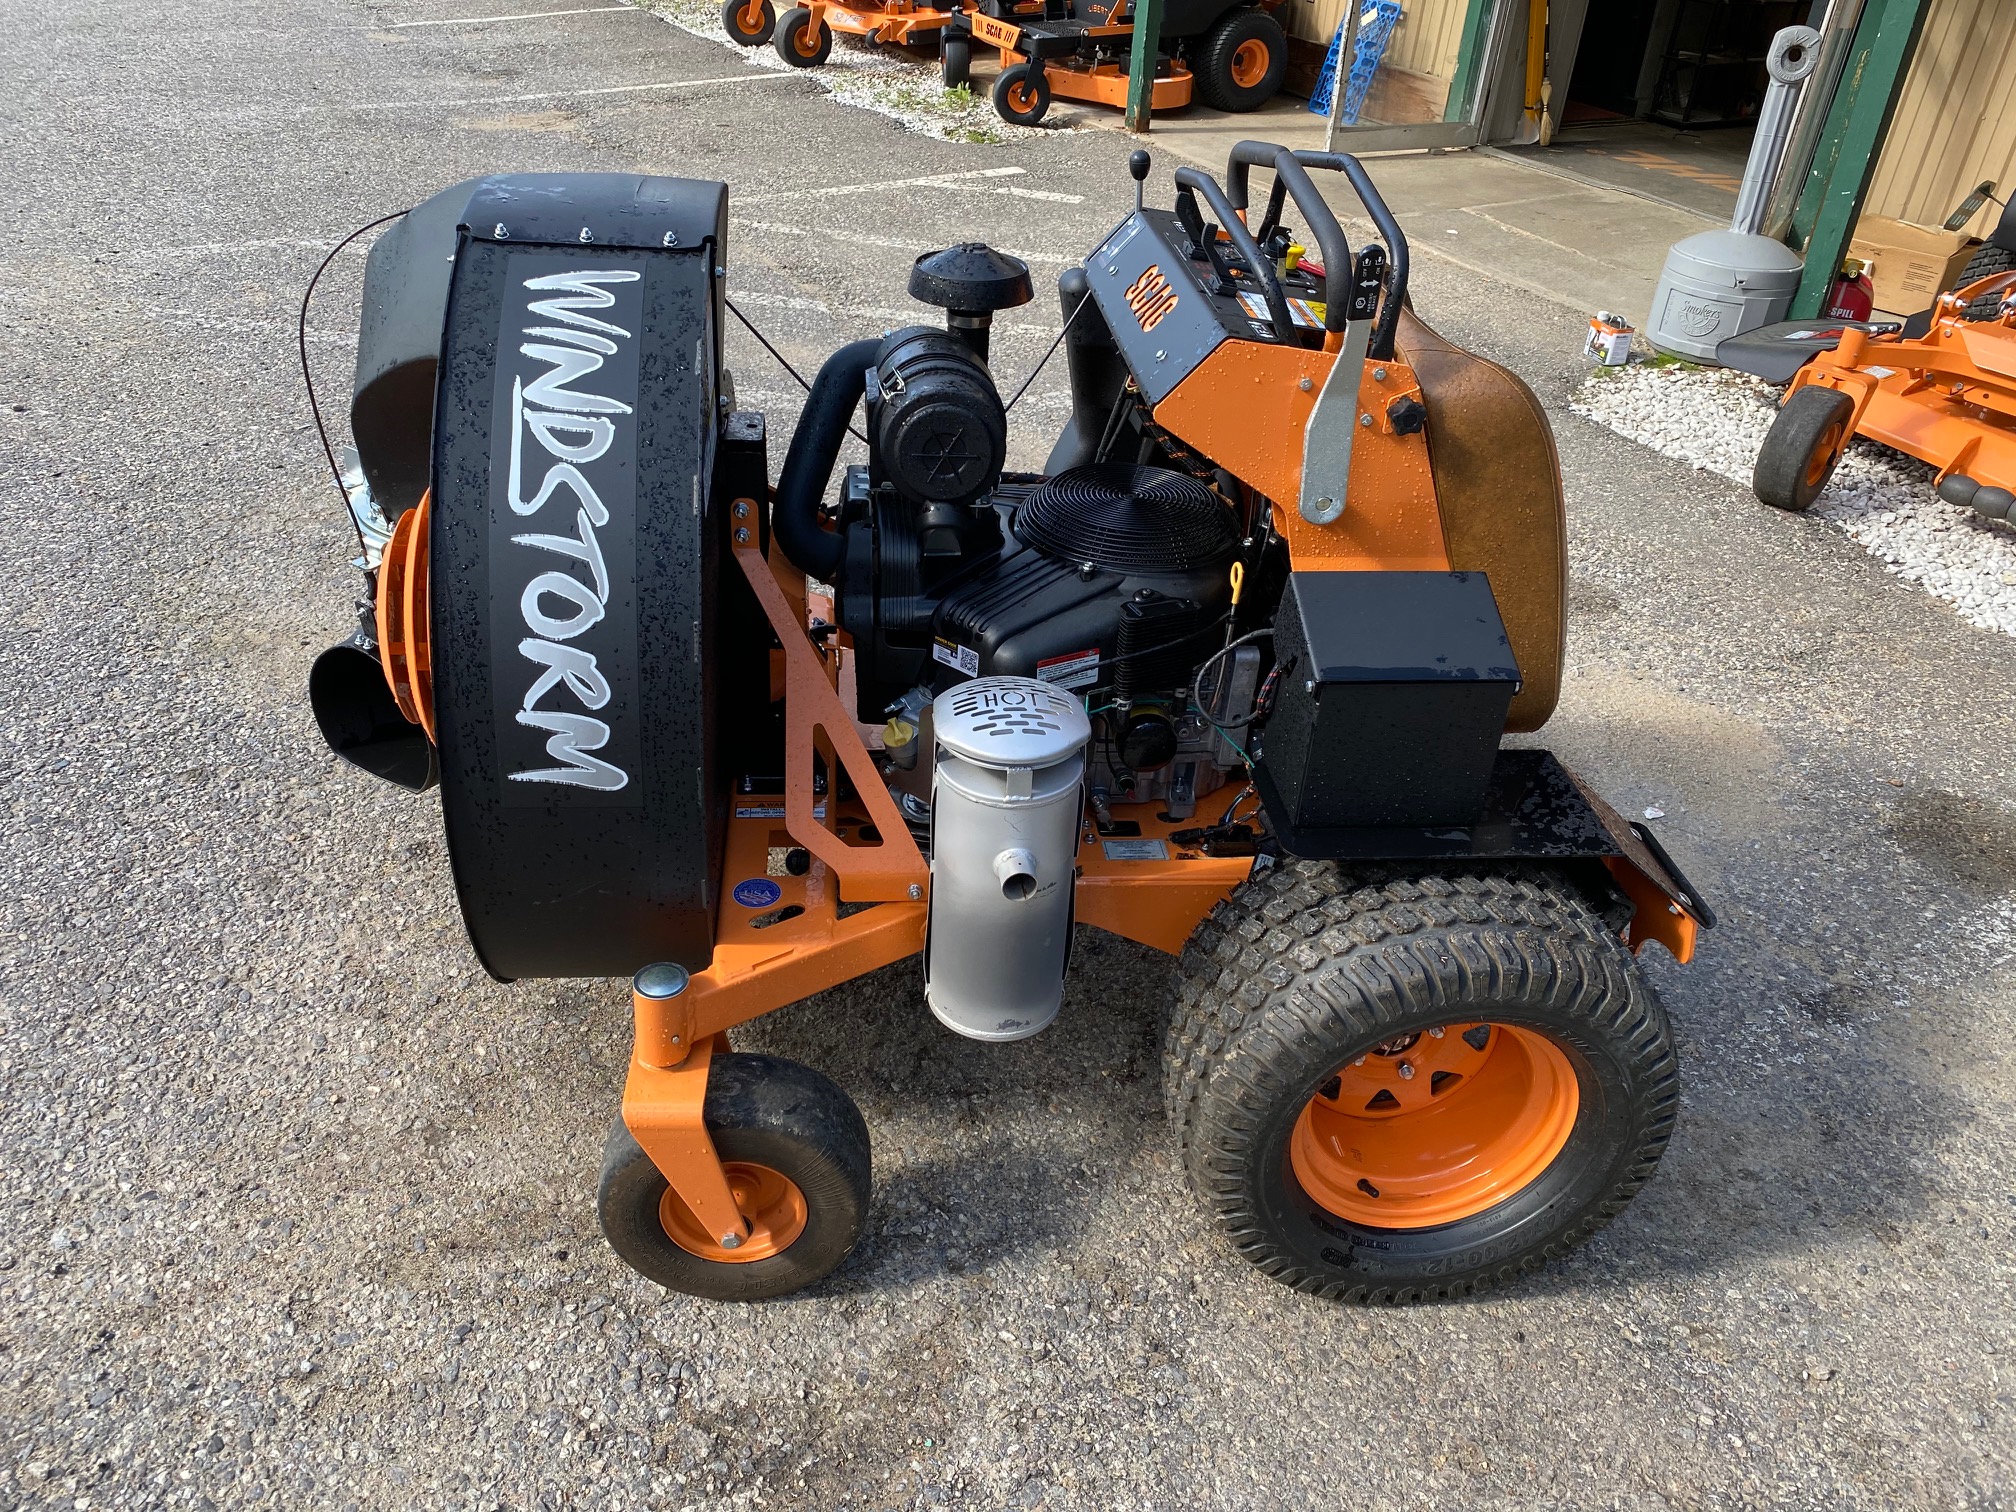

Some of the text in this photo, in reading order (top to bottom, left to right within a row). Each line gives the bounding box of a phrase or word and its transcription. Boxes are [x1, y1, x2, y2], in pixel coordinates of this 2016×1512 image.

[985, 22, 1003, 40] SCAG
[1124, 264, 1179, 333] SCAG
[1681, 300, 1722, 320] Smokers
[1828, 306, 1855, 319] -SPILL
[507, 269, 641, 792] WINDSTORM
[984, 691, 1039, 707] HOT
[744, 889, 773, 897] USA
